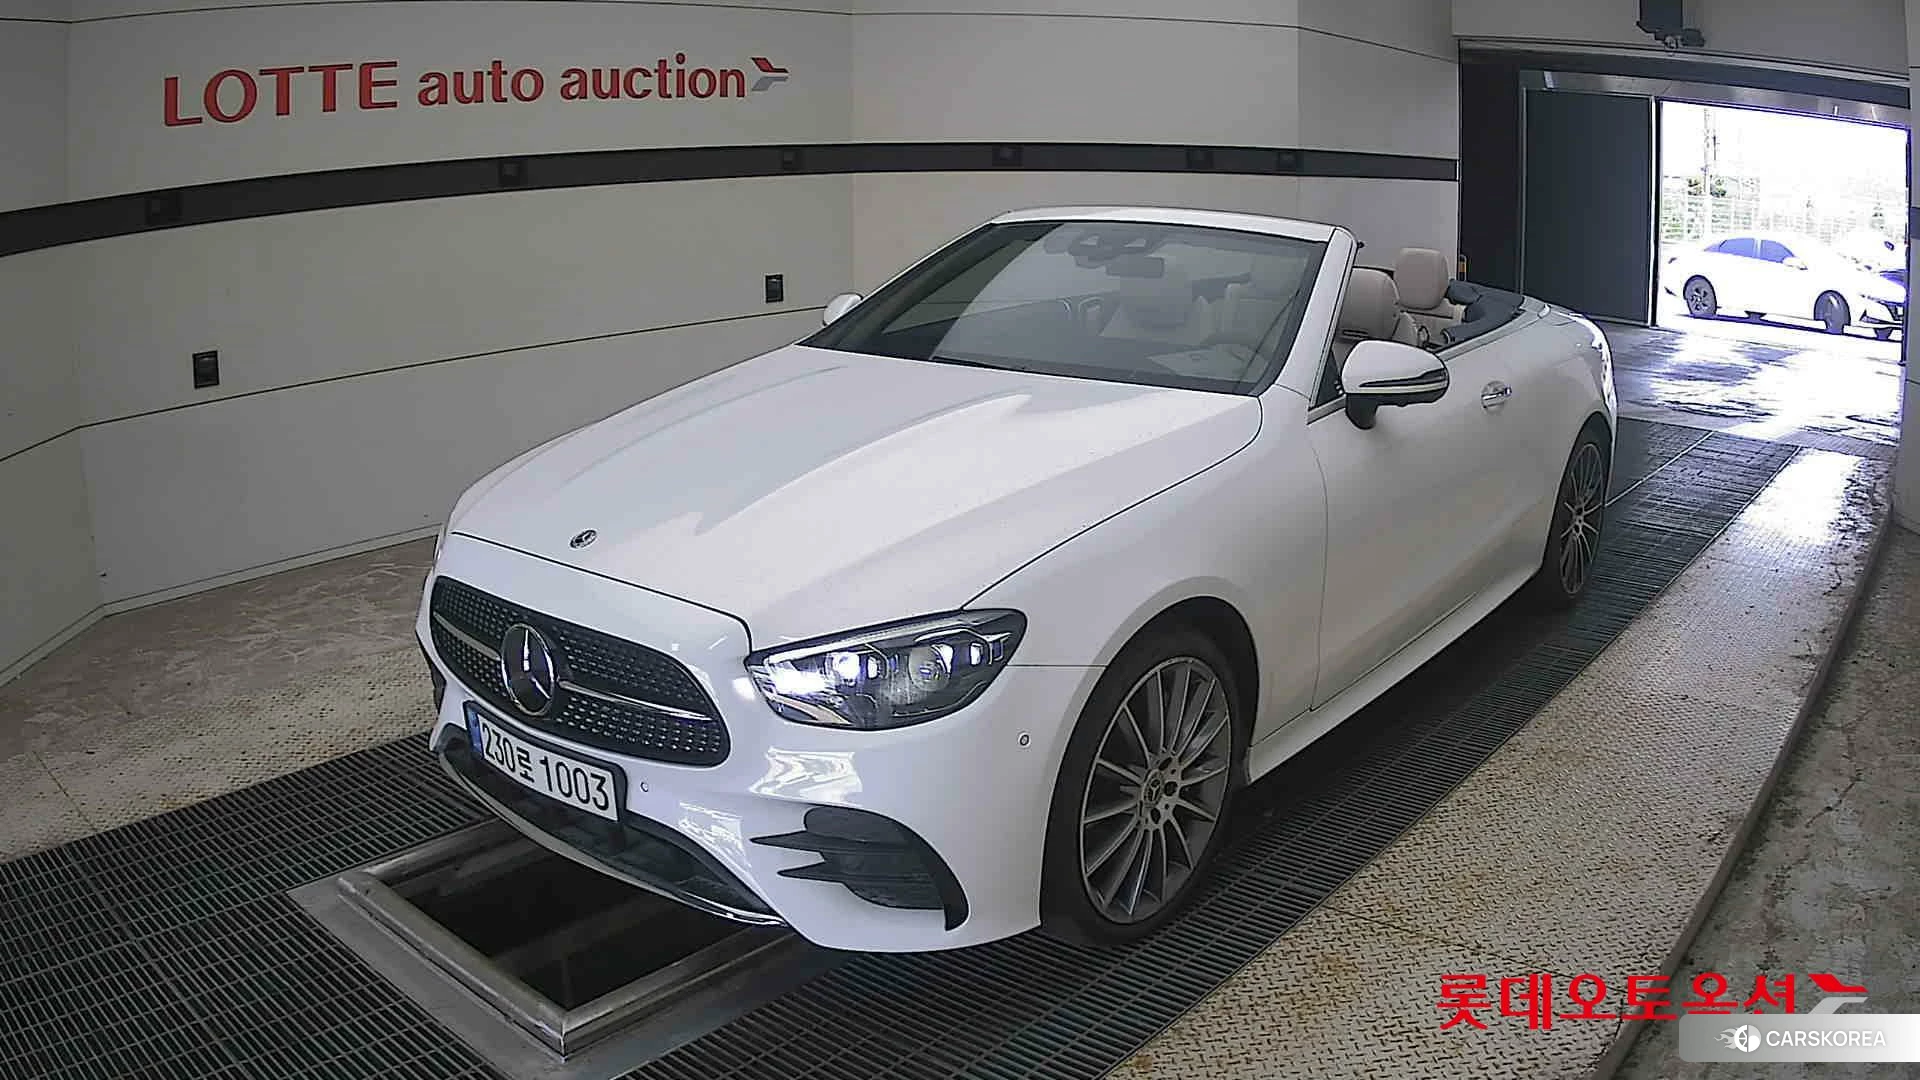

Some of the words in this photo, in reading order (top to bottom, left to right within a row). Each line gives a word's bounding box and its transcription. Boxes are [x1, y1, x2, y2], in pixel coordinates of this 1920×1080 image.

[164, 61, 398, 126] LOTTE
[417, 60, 545, 106] auto
[560, 53, 746, 100] auction
[482, 722, 535, 783] 230로
[540, 756, 609, 811] 1003
